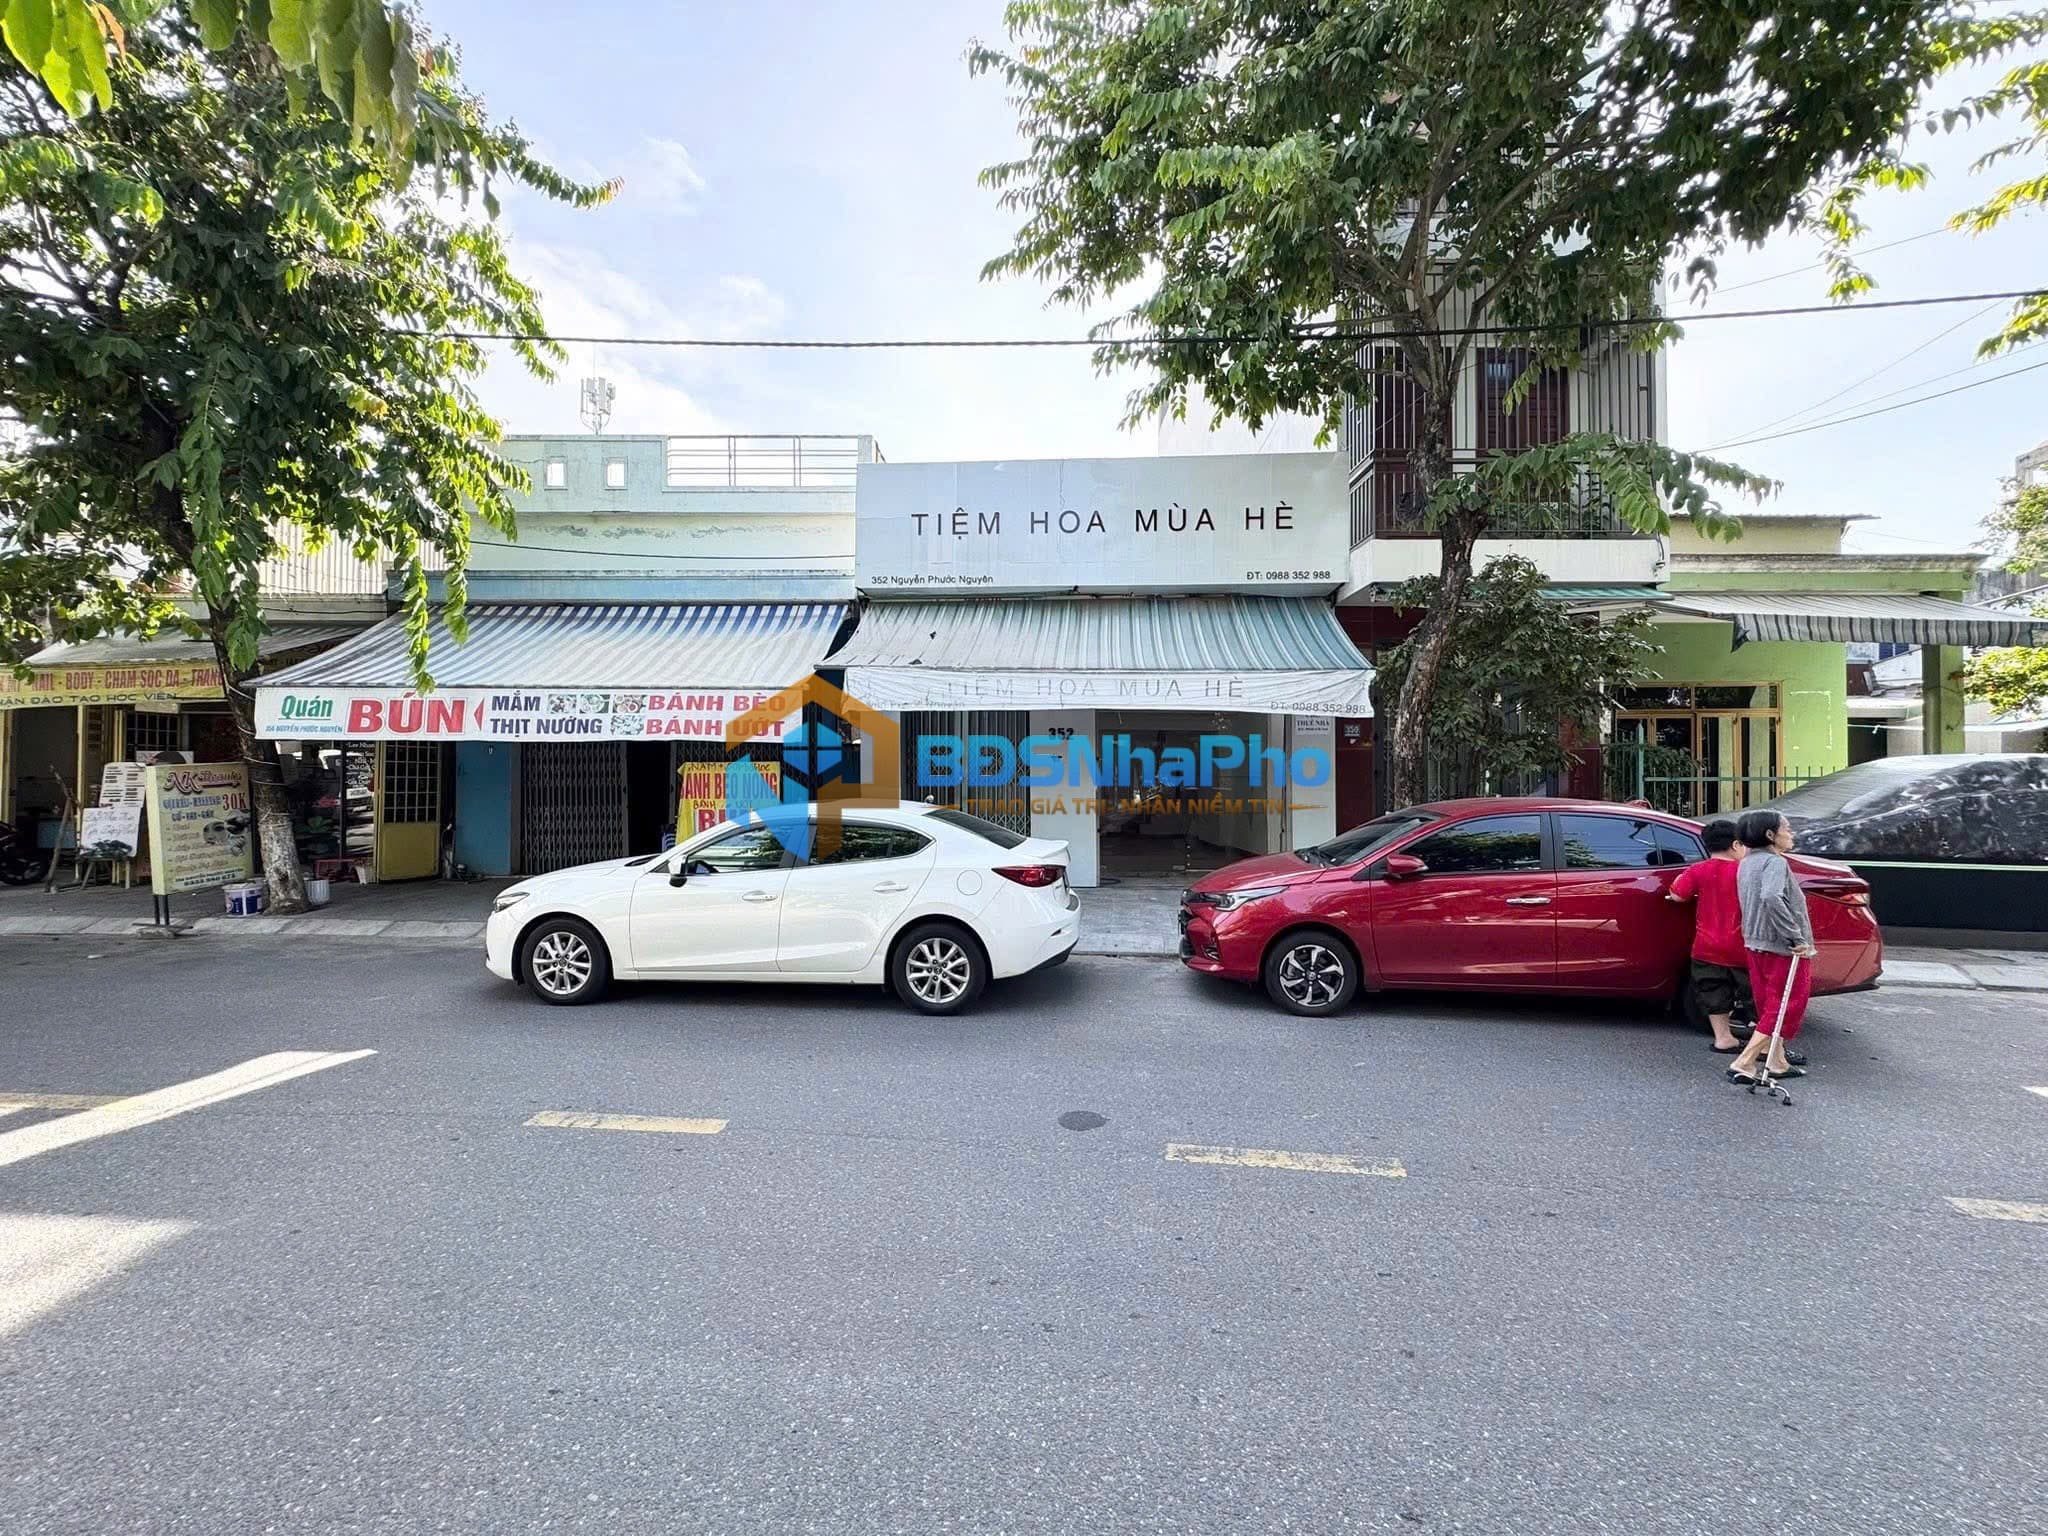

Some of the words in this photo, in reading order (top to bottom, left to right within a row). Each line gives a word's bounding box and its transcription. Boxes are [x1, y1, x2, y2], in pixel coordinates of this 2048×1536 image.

[911, 507, 1001, 540] TIỆM
[1030, 510, 1106, 534] HOA
[1135, 502, 1215, 532] MÙA
[1245, 500, 1294, 530] HÈ
[871, 576, 888, 584] 352
[891, 574, 925, 585] Nguyễn
[1266, 571, 1289, 580] 0988
[1292, 571, 1310, 579] 352
[1313, 570, 1331, 579] 988
[66, 671, 94, 690] BODY
[1205, 675, 1243, 697] HÈ
[281, 695, 333, 719] Quán
[649, 693, 724, 711] BÁNH
[733, 693, 785, 711] BÈO
[1322, 703, 1342, 713] 352
[347, 692, 465, 733] BÚN
[490, 718, 531, 737] THỊT
[536, 715, 602, 735] NƯỚNG
[646, 716, 722, 735] BÁNH
[1048, 728, 1074, 741] 352
[222, 793, 247, 811] 30K
